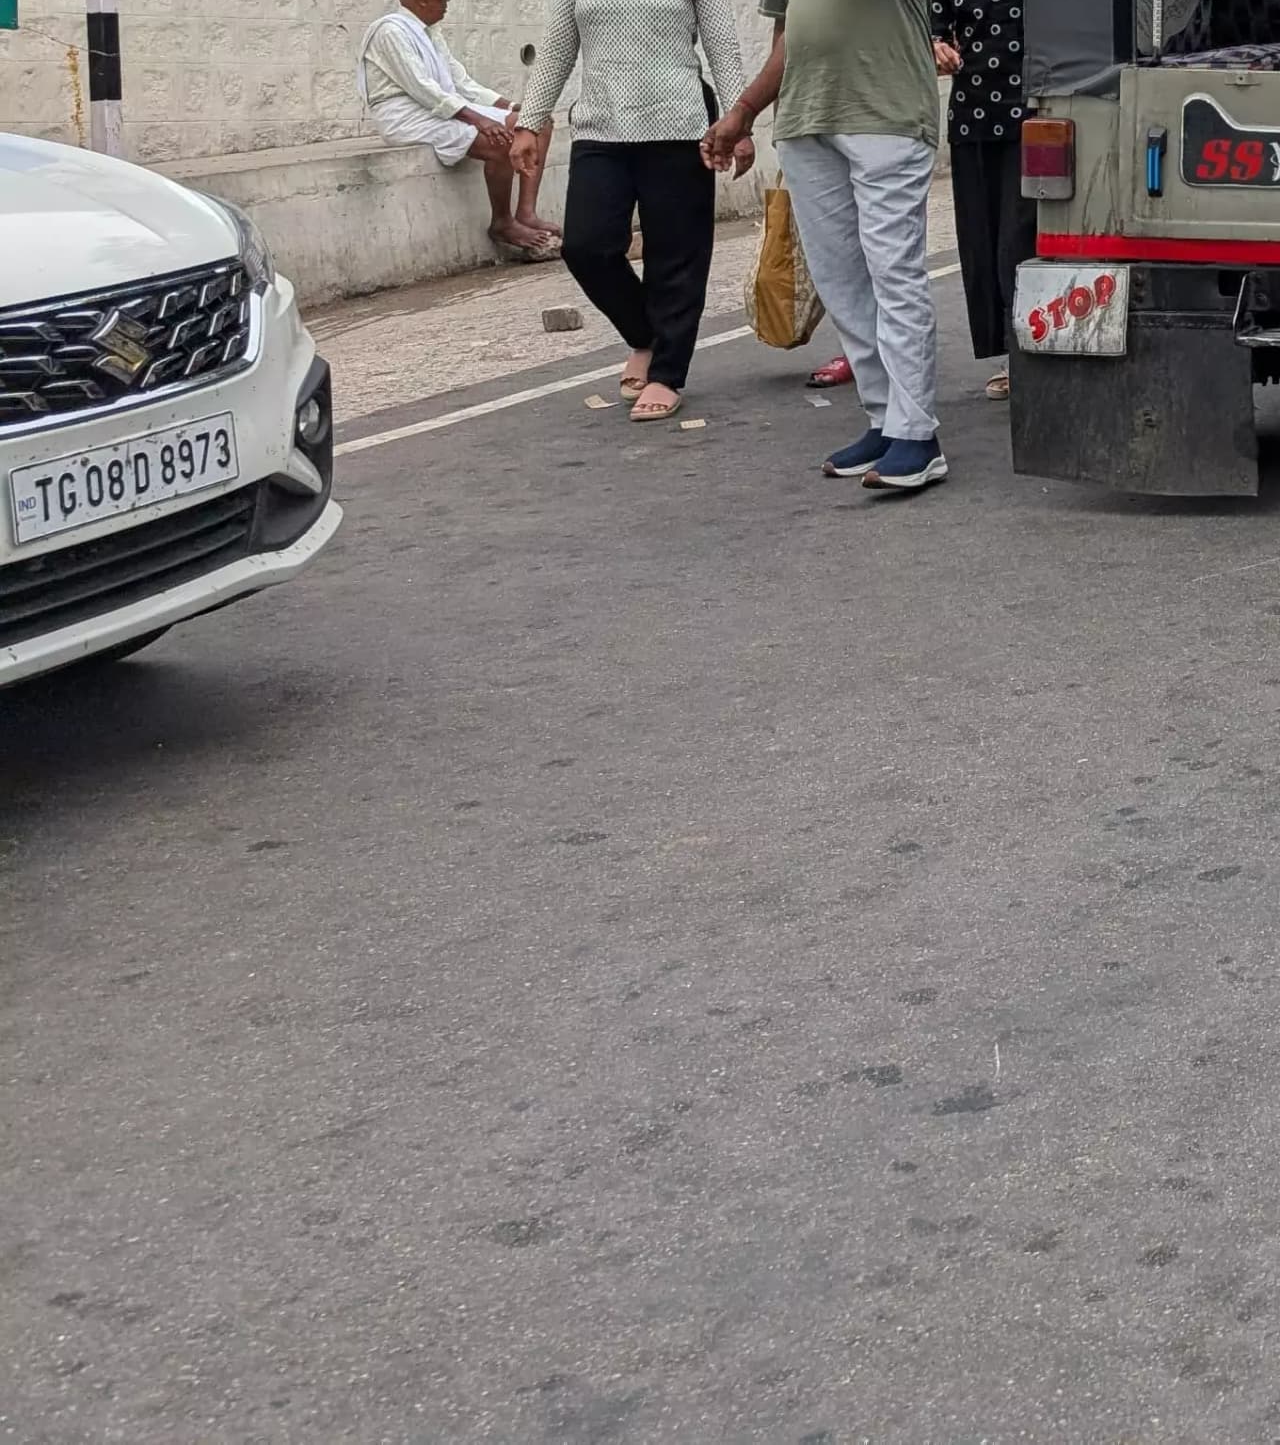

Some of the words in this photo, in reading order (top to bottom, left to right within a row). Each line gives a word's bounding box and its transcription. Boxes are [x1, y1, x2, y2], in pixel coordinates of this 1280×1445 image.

[1196, 139, 1265, 181] SS
[1028, 274, 1117, 345] STOP
[35, 472, 77, 522] TG
[86, 459, 125, 507] 08
[133, 452, 150, 494] D
[160, 428, 232, 485] 8973
